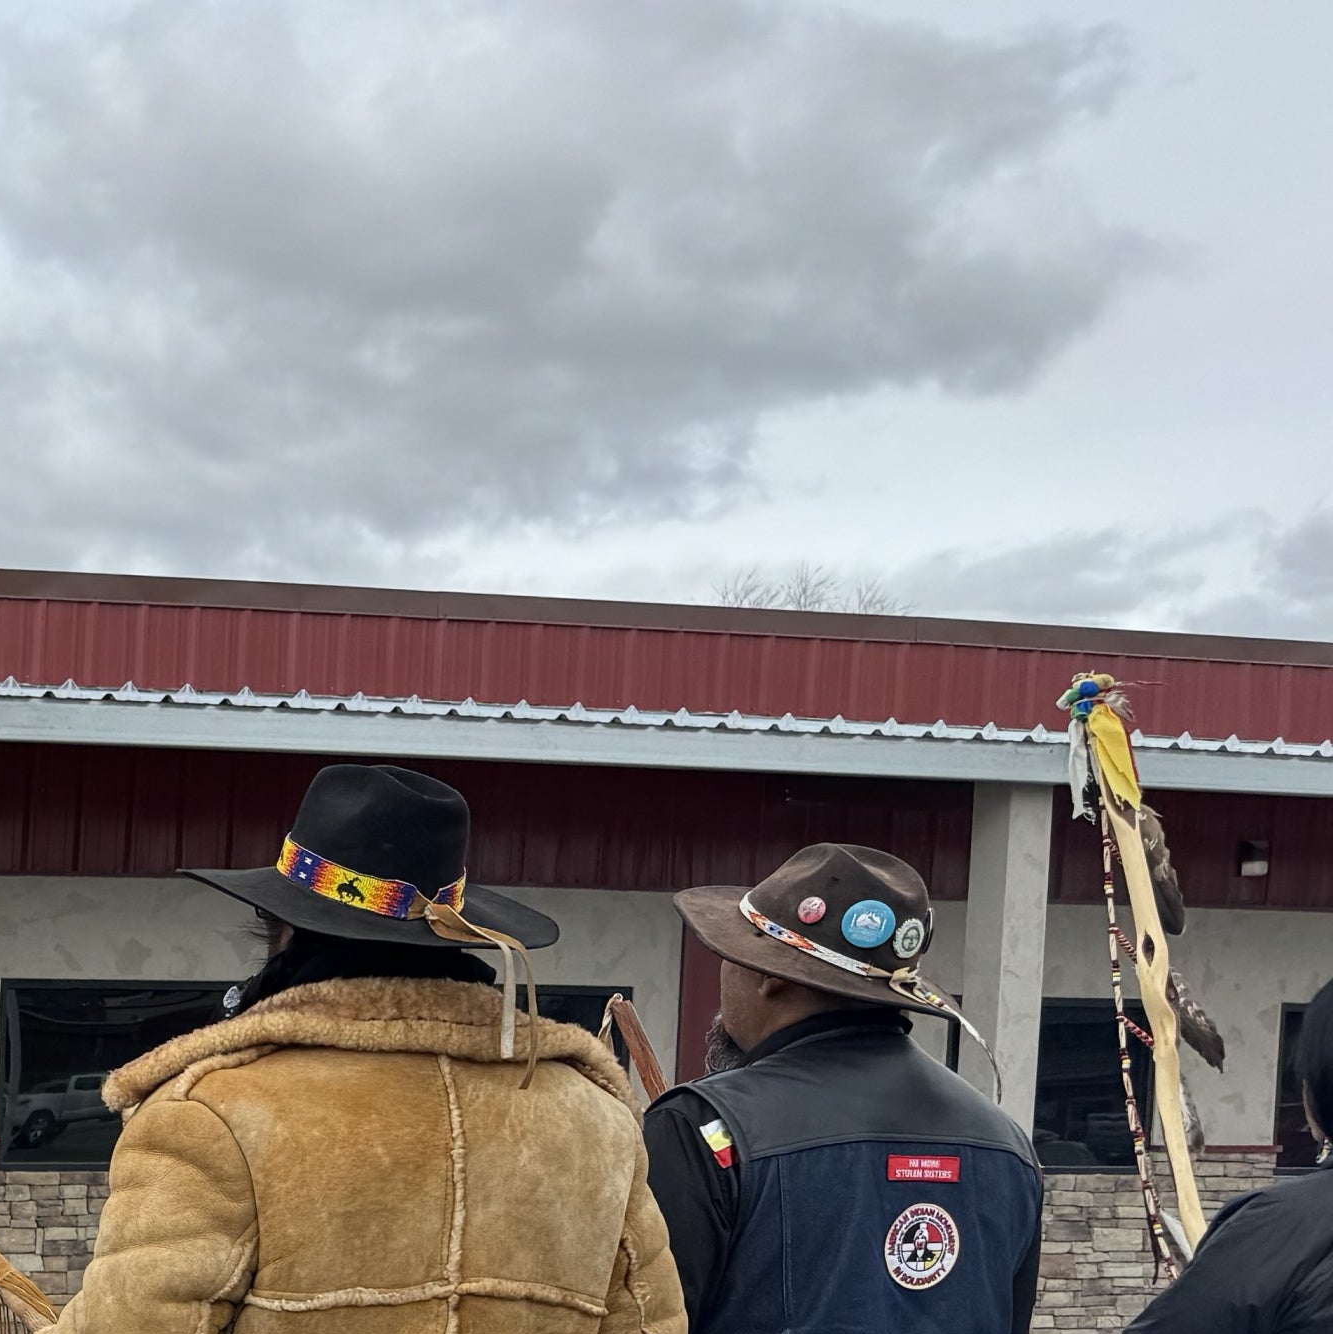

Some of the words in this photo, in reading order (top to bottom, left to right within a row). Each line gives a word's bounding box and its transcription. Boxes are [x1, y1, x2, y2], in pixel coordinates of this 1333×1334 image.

[923, 1170, 953, 1179] SISTERS
[887, 1213, 910, 1256] AMERICAN
[909, 1207, 936, 1218] INDIAN
[935, 1211, 956, 1256] MOVEMENT
[892, 1266, 902, 1278] IN
[900, 1264, 947, 1286] SOLIDARITY
